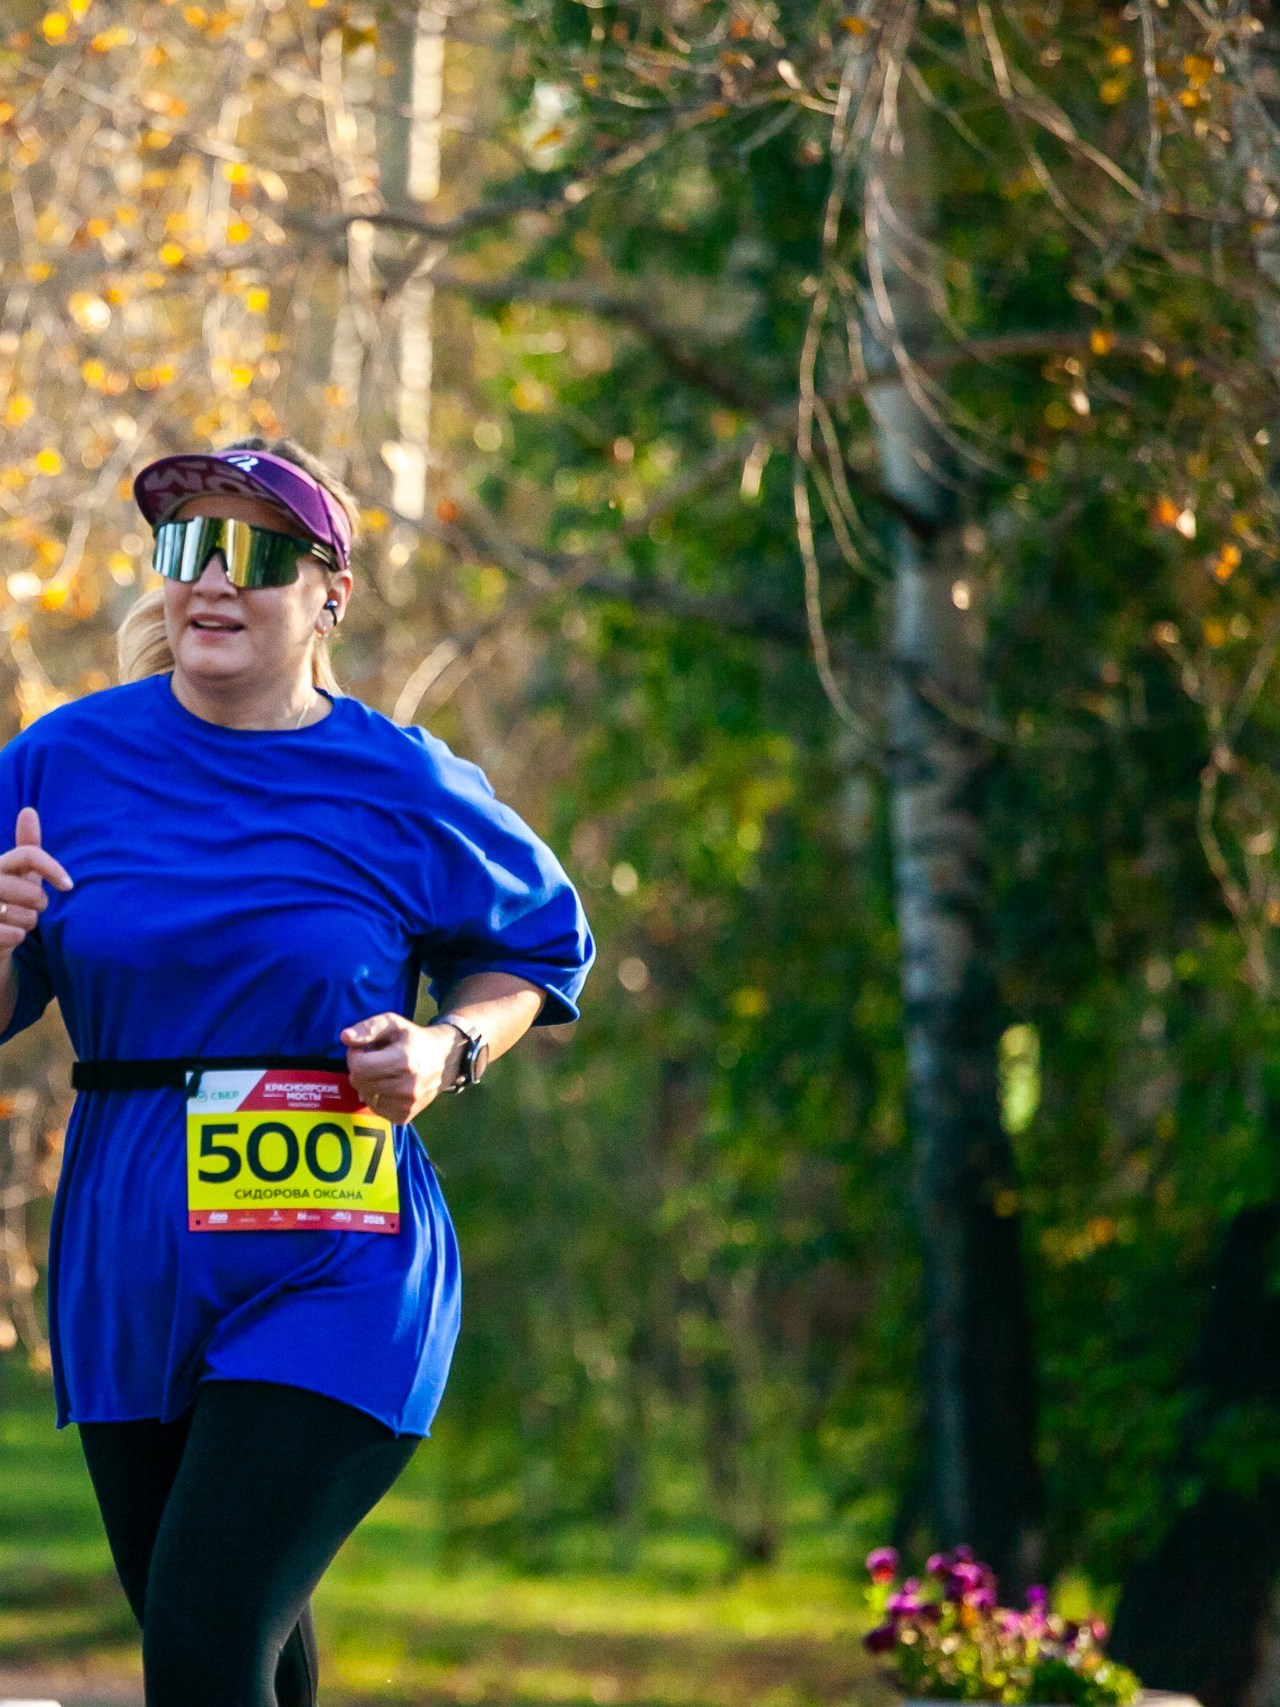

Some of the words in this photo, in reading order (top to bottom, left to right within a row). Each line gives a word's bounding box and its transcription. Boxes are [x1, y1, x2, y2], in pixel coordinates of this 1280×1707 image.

[264, 1083, 339, 1094] КРАСНОЯРСКИЕ
[210, 1090, 239, 1100] СБЕР
[287, 1092, 322, 1101] МОСТЫ
[198, 1121, 386, 1184] 5007
[234, 1188, 309, 1201] СИДОРОВА
[314, 1189, 363, 1201] ОКСАНА
